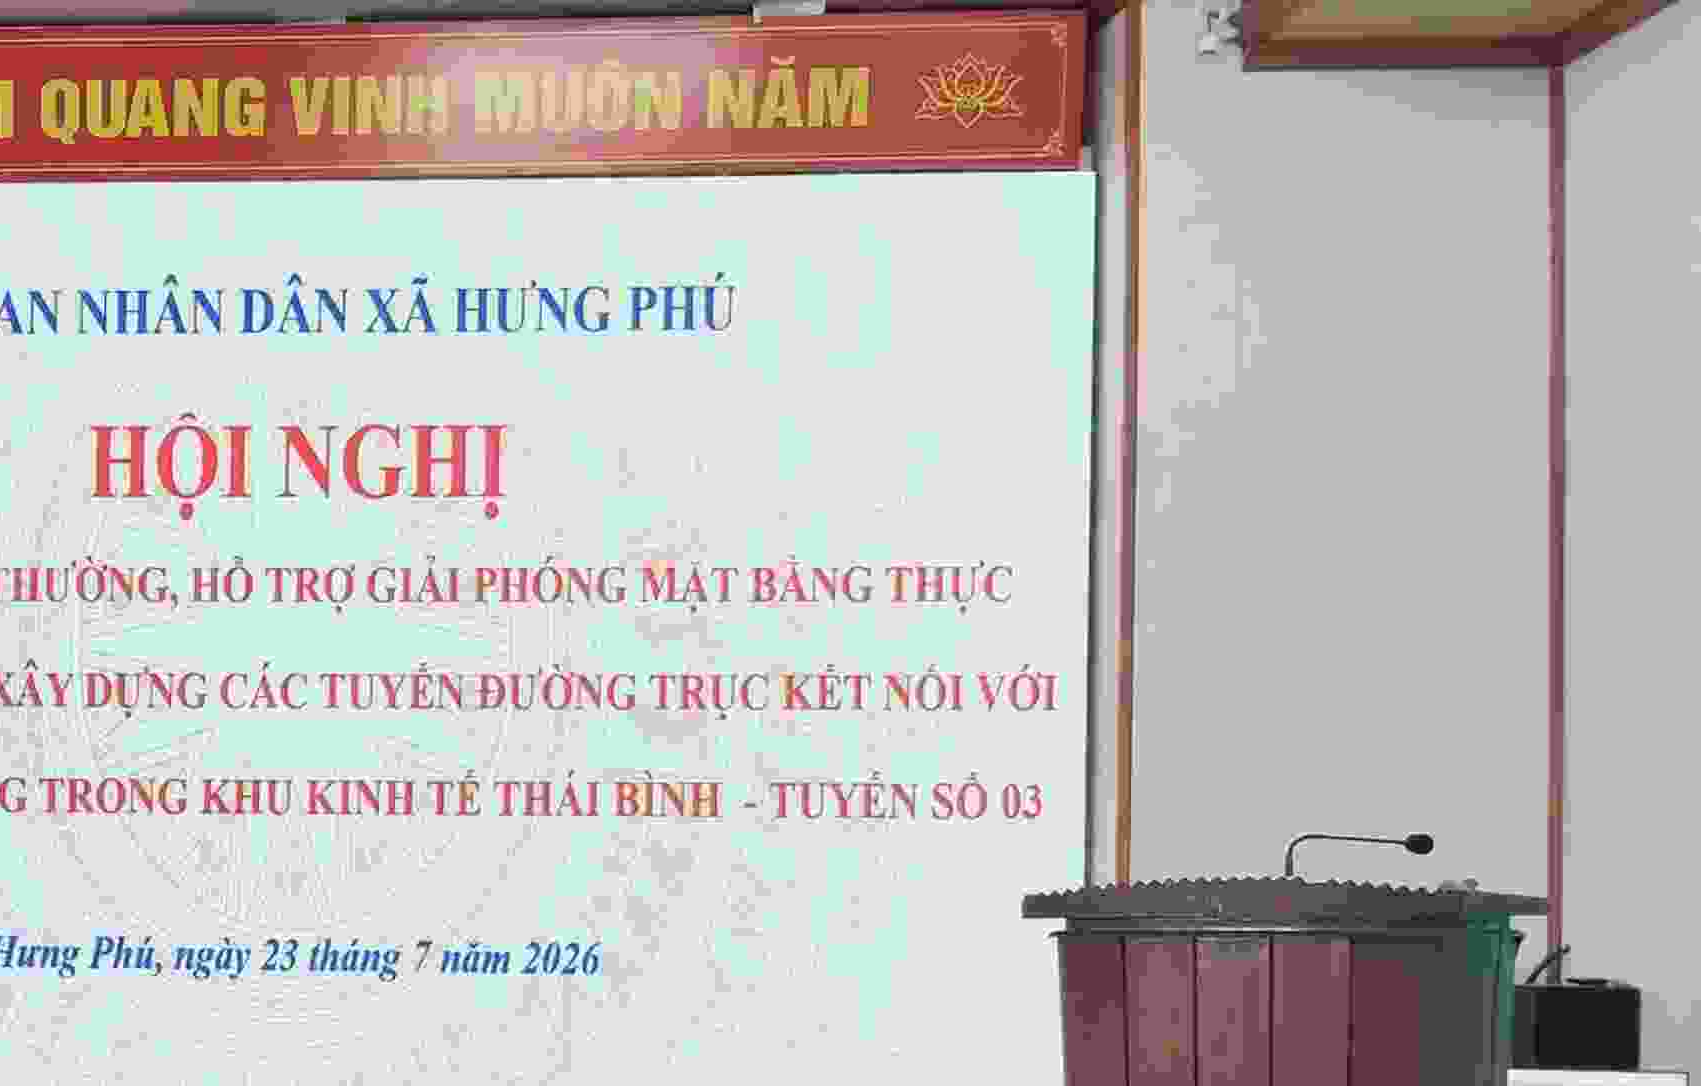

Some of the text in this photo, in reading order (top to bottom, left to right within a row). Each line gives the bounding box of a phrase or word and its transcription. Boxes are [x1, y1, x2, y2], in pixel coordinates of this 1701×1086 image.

[40, 75, 267, 144] QUANG
[290, 76, 448, 137] VINH
[473, 60, 682, 135] MUÔN
[706, 56, 870, 130] NĂM
[77, 273, 224, 334] NHÂN
[241, 272, 347, 334] DÂN
[365, 276, 436, 333] XÃ
[455, 279, 611, 333] HƯNG
[629, 271, 736, 332] PHÚ
[91, 412, 507, 520] HỘI NGHỊ
[266, 563, 356, 614] TRỢ
[367, 555, 460, 602] GIẢI
[475, 556, 627, 603] PHÓNG
[642, 564, 738, 614] MẶT
[751, 555, 872, 603] BẰNG
[885, 561, 1013, 614] THỰC
[85, 667, 207, 719] DỰNG
[220, 660, 308, 709] CÁC
[320, 662, 462, 710] TUYẾN
[477, 663, 636, 711] ĐƯỜNG
[648, 672, 770, 720] TRỤC
[781, 664, 872, 711] KẾT
[884, 665, 963, 711] NỐI
[979, 664, 1060, 711] VỚI
[39, 777, 188, 816] TRONG
[202, 780, 293, 816] KHU
[307, 780, 415, 816] KINH
[427, 769, 482, 817] TẾ
[494, 769, 600, 817] THÁI
[615, 770, 723, 818] BÌNH
[770, 772, 919, 819] TUYẾN
[931, 771, 988, 819] SỐ
[1002, 783, 1043, 819] 03
[89, 935, 163, 976] Phú,
[172, 937, 253, 980] ngày
[261, 938, 300, 973] 23
[308, 938, 403, 981] tháng
[415, 940, 433, 972] 7
[440, 940, 511, 974] năm
[520, 940, 601, 976] 2026
